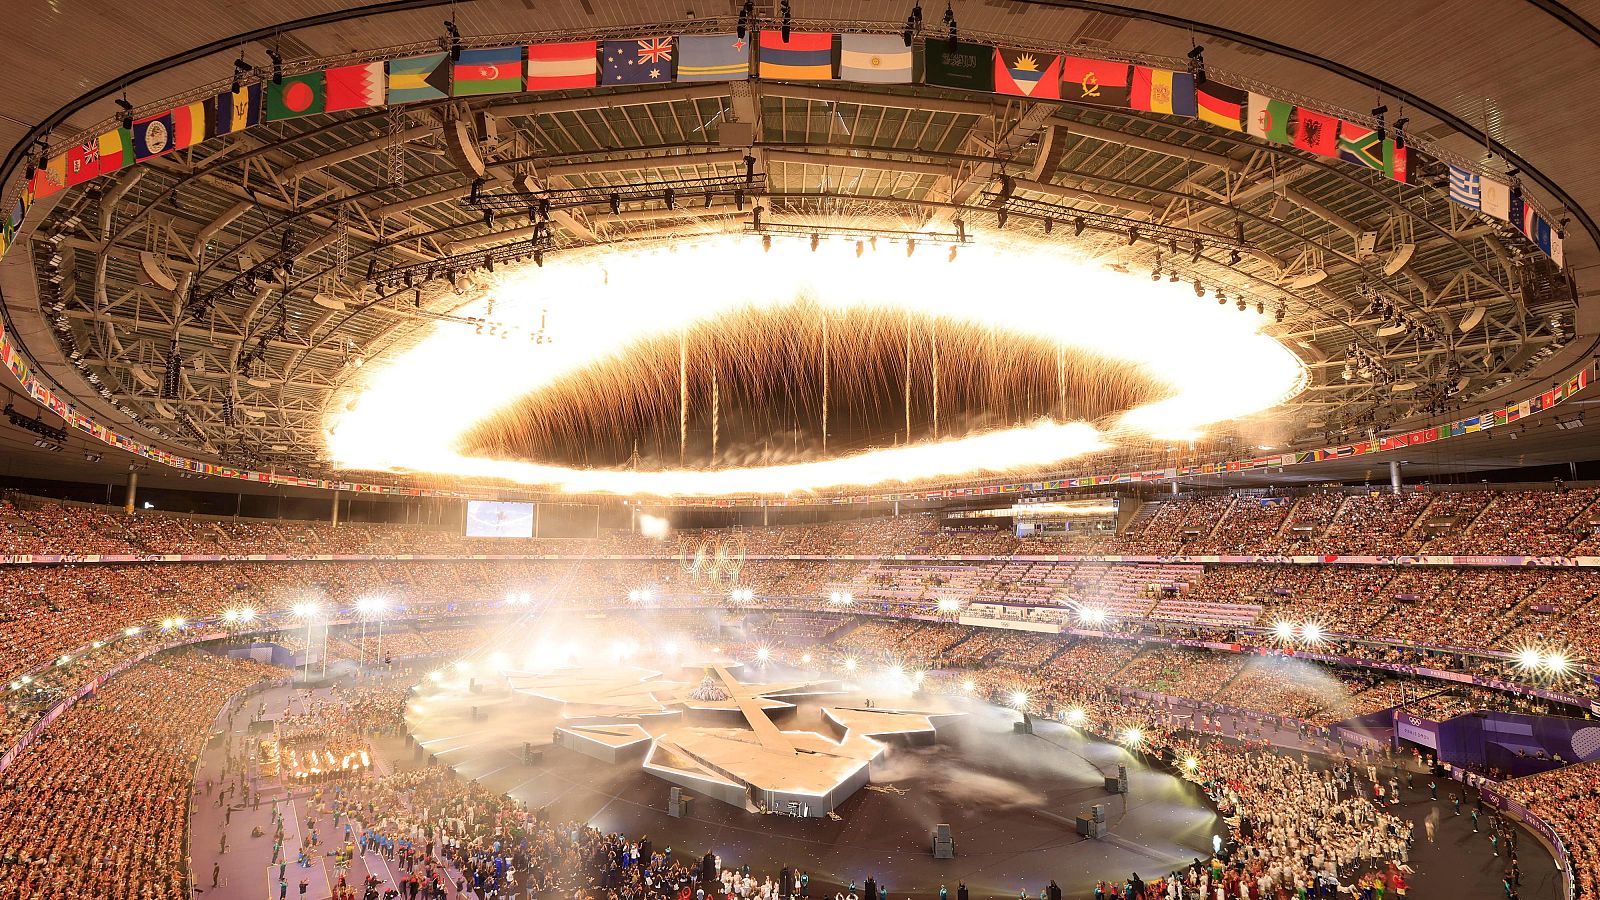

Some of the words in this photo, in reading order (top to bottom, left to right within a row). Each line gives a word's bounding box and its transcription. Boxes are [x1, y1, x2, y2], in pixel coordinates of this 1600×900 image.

[1563, 696, 1578, 704] 2024
[1343, 731, 1359, 741] PARIS
[1404, 728, 1417, 736] PARIS
[1418, 732, 1430, 740] 2024
